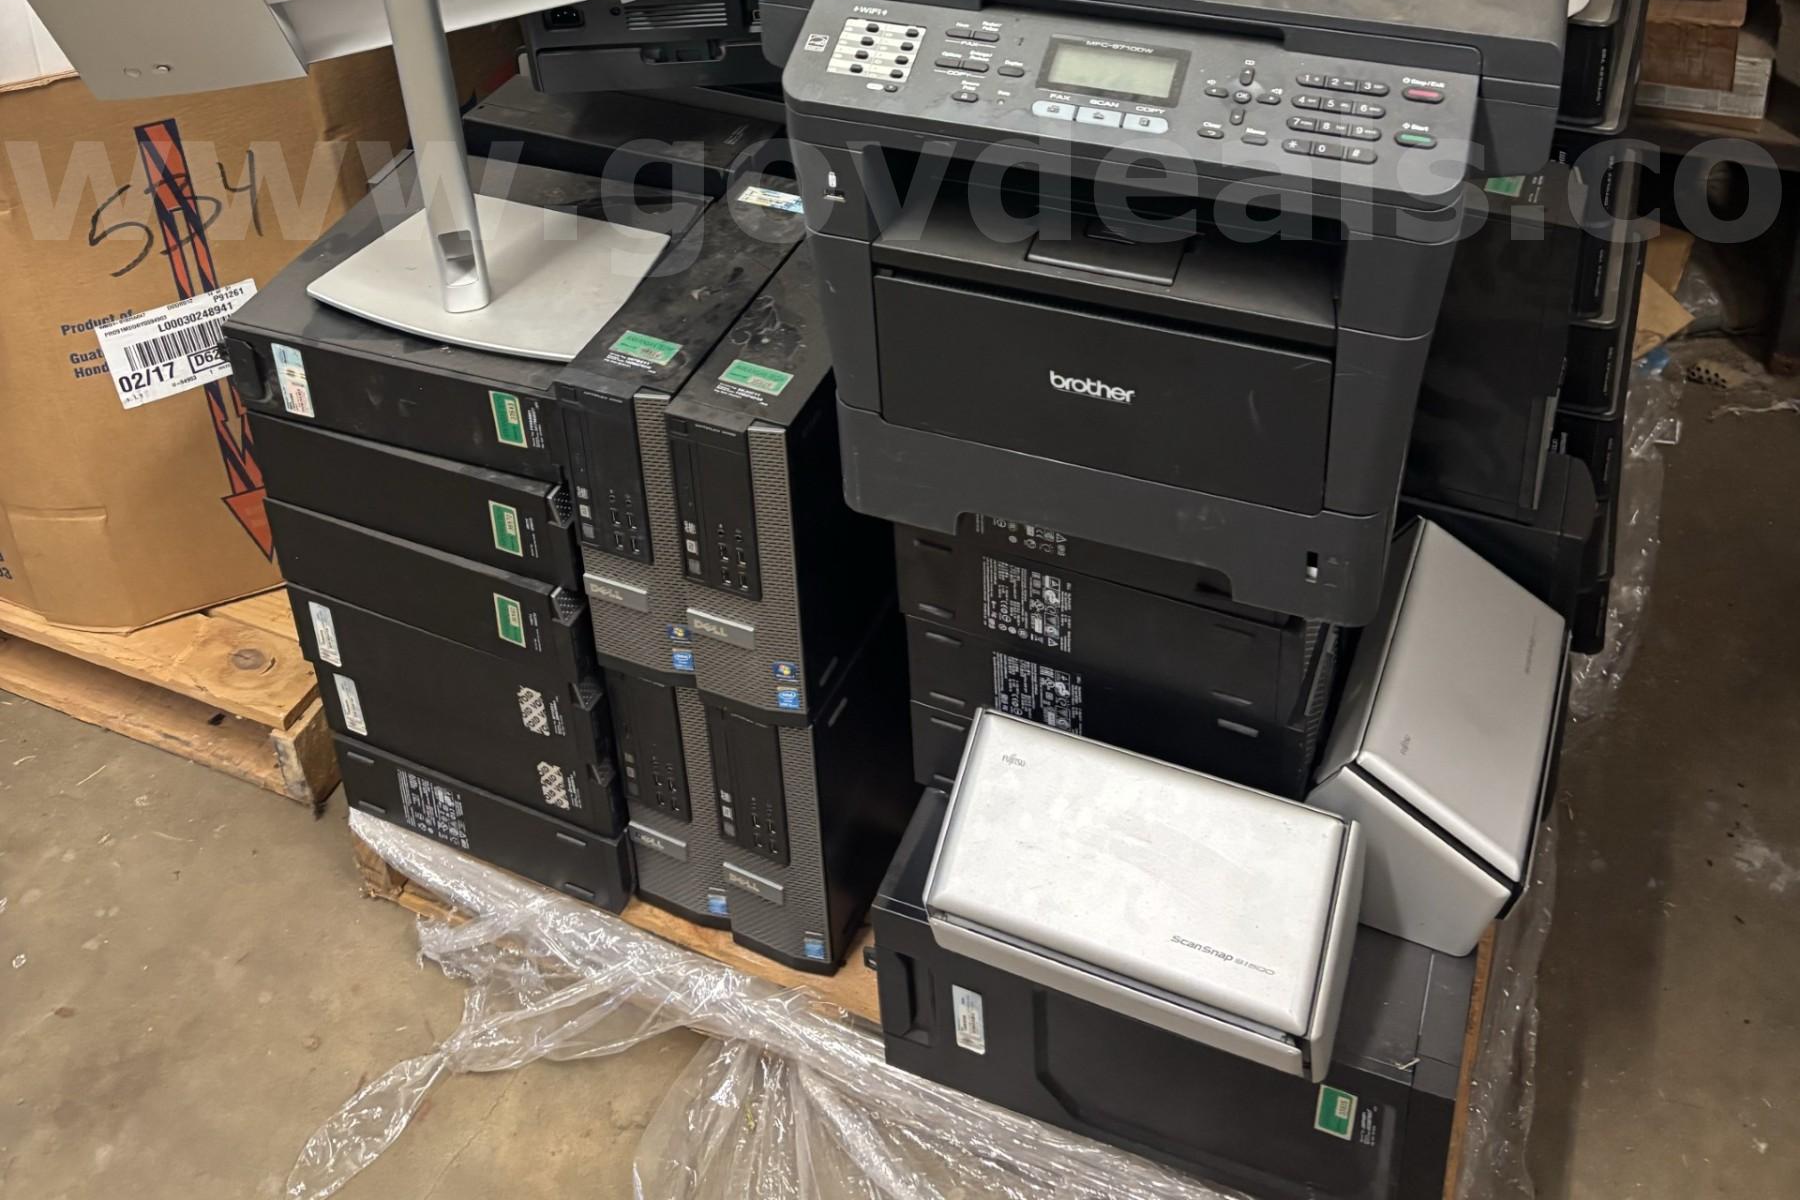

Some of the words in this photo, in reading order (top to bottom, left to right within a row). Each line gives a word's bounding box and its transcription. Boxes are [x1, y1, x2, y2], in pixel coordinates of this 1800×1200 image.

[1089, 99, 1120, 108] SCAN
[1135, 106, 1166, 114] COPY
[212, 287, 244, 303] P91261
[61, 313, 116, 336] Product
[157, 302, 234, 333] L00030248941
[69, 348, 104, 365] Guat
[74, 363, 109, 379] Hond
[118, 362, 176, 393] 02/17
[1049, 369, 1136, 403] brother
[1170, 935, 1234, 962] ScanSnap
